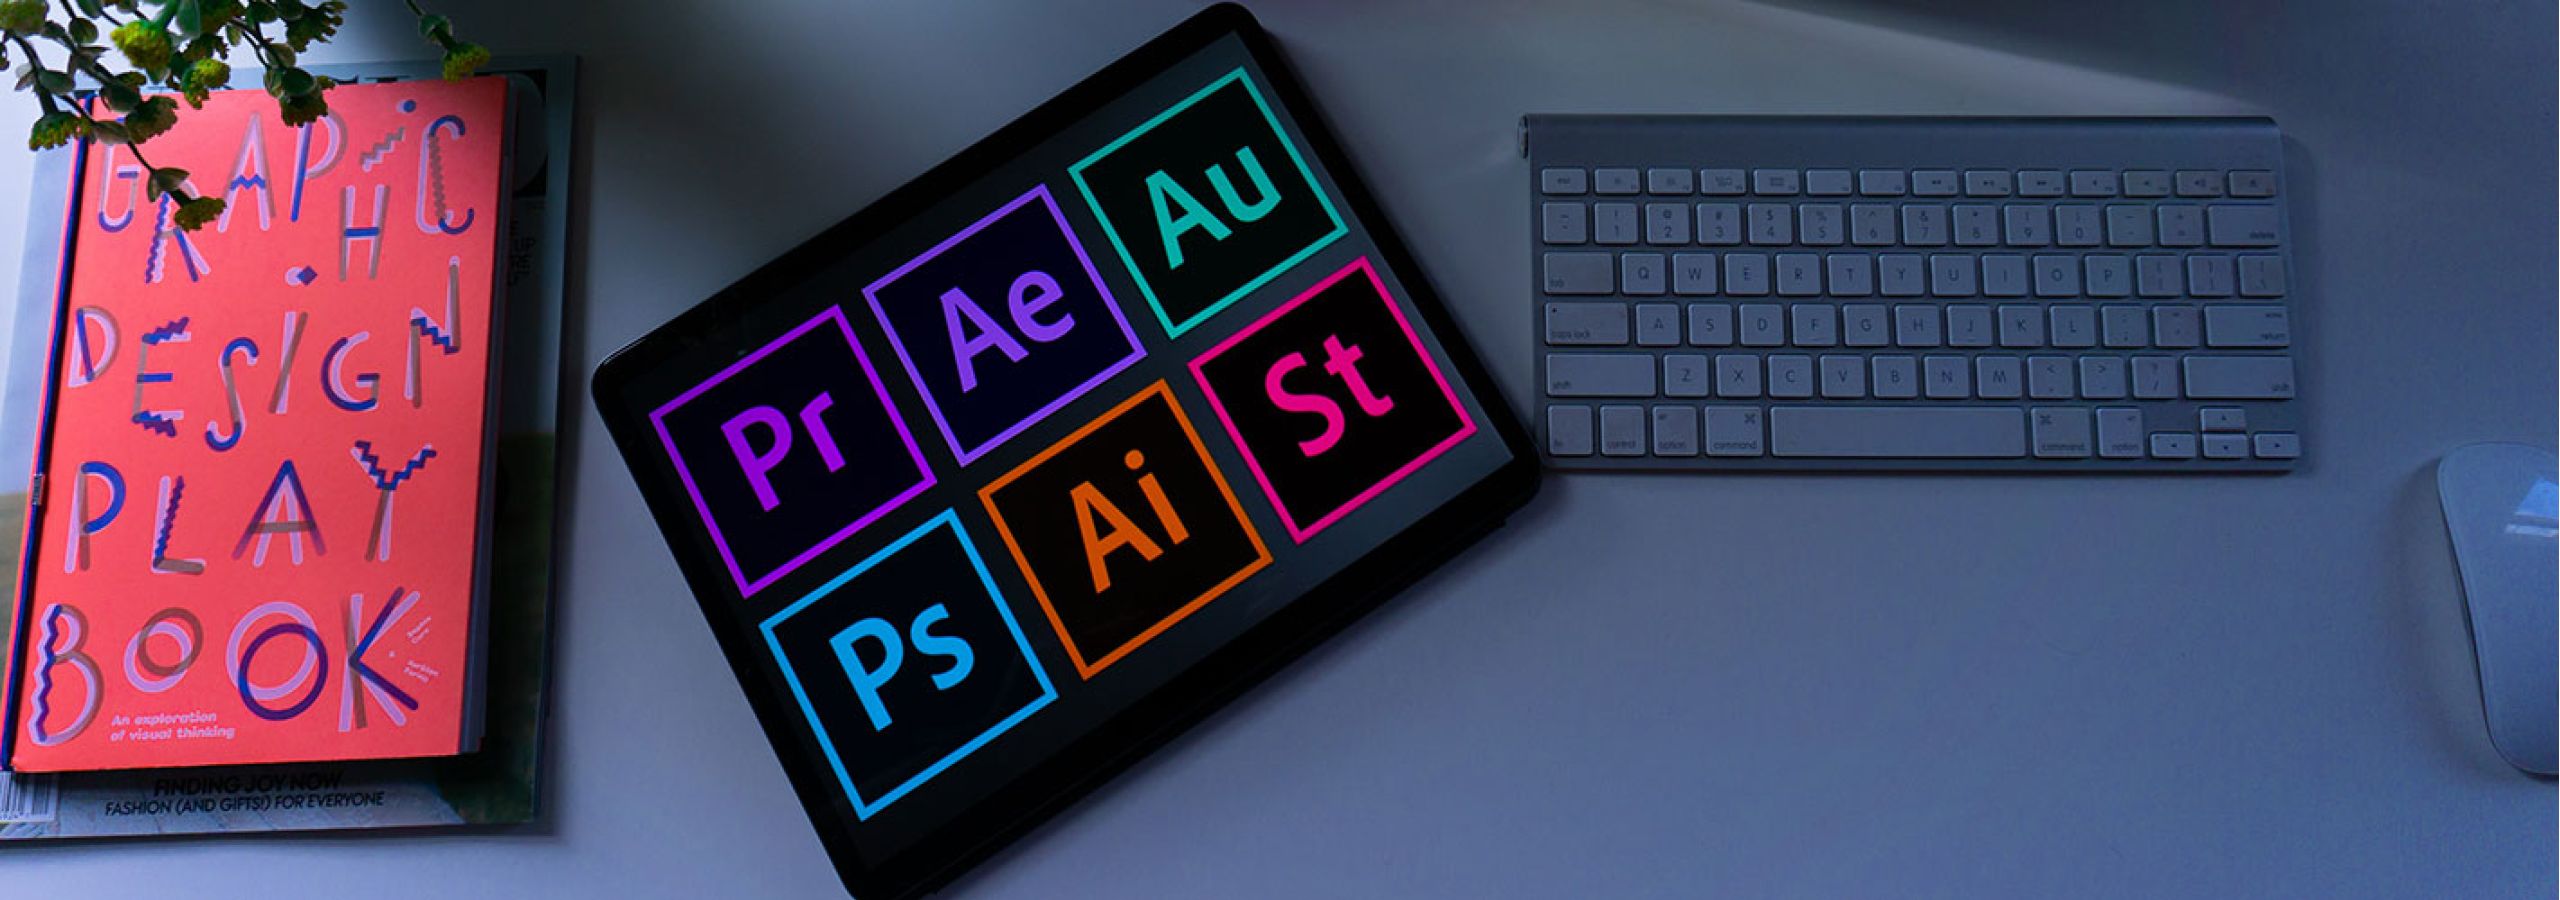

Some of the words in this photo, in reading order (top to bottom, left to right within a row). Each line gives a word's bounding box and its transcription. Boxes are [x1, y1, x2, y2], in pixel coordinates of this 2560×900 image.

[1145, 145, 1282, 270] Au
[1663, 226, 1672, 238] 2
[1714, 226, 1724, 238] 3
[1767, 226, 1774, 237] 4
[1818, 226, 1826, 238] 5
[1870, 227, 1878, 239] 6
[1921, 226, 1929, 238] 7
[2024, 227, 2032, 239] 9
[1637, 266, 1650, 281] Q
[1688, 267, 1702, 281] W
[1744, 267, 1752, 281] E
[1795, 267, 1803, 281] R
[1846, 268, 1855, 281] T
[1897, 267, 1906, 281] Y
[1948, 269, 1959, 282] U
[2104, 269, 2113, 282] P
[68, 256, 461, 450] DESIGN
[940, 270, 1075, 393] Ae
[1653, 318, 1664, 330] A
[1705, 318, 1715, 332] S
[1757, 318, 1768, 331] D
[1811, 318, 1820, 331] F
[1861, 318, 1872, 332] G
[1913, 318, 1923, 331] H
[1967, 320, 1974, 333] J
[2017, 319, 2027, 332] K
[2070, 320, 2078, 333] L
[1265, 334, 1394, 458] St
[1681, 368, 1691, 382] Z
[1732, 368, 1744, 383] X
[1785, 369, 1795, 383] C
[1838, 370, 1848, 383] V
[1891, 370, 1900, 383] B
[1941, 370, 1953, 383] N
[1993, 370, 2007, 384] M
[721, 391, 846, 512] Pr
[1713, 440, 1757, 450] command
[64, 440, 437, 575] PLAY
[1070, 449, 1190, 593] Ai
[28, 586, 420, 745] BOOK
[828, 603, 974, 731] Ps
[110, 729, 125, 741] of
[129, 728, 172, 740] visual
[176, 726, 236, 740] thinking
[111, 715, 130, 726] An
[134, 710, 217, 726] exploration
[105, 800, 172, 816] FASHION
[176, 799, 217, 815] (AND
[274, 794, 304, 810] FOR
[307, 791, 385, 808] EVERYONE
[154, 776, 240, 797] FINDING
[244, 773, 287, 793] JOY
[289, 770, 344, 791] NOW
